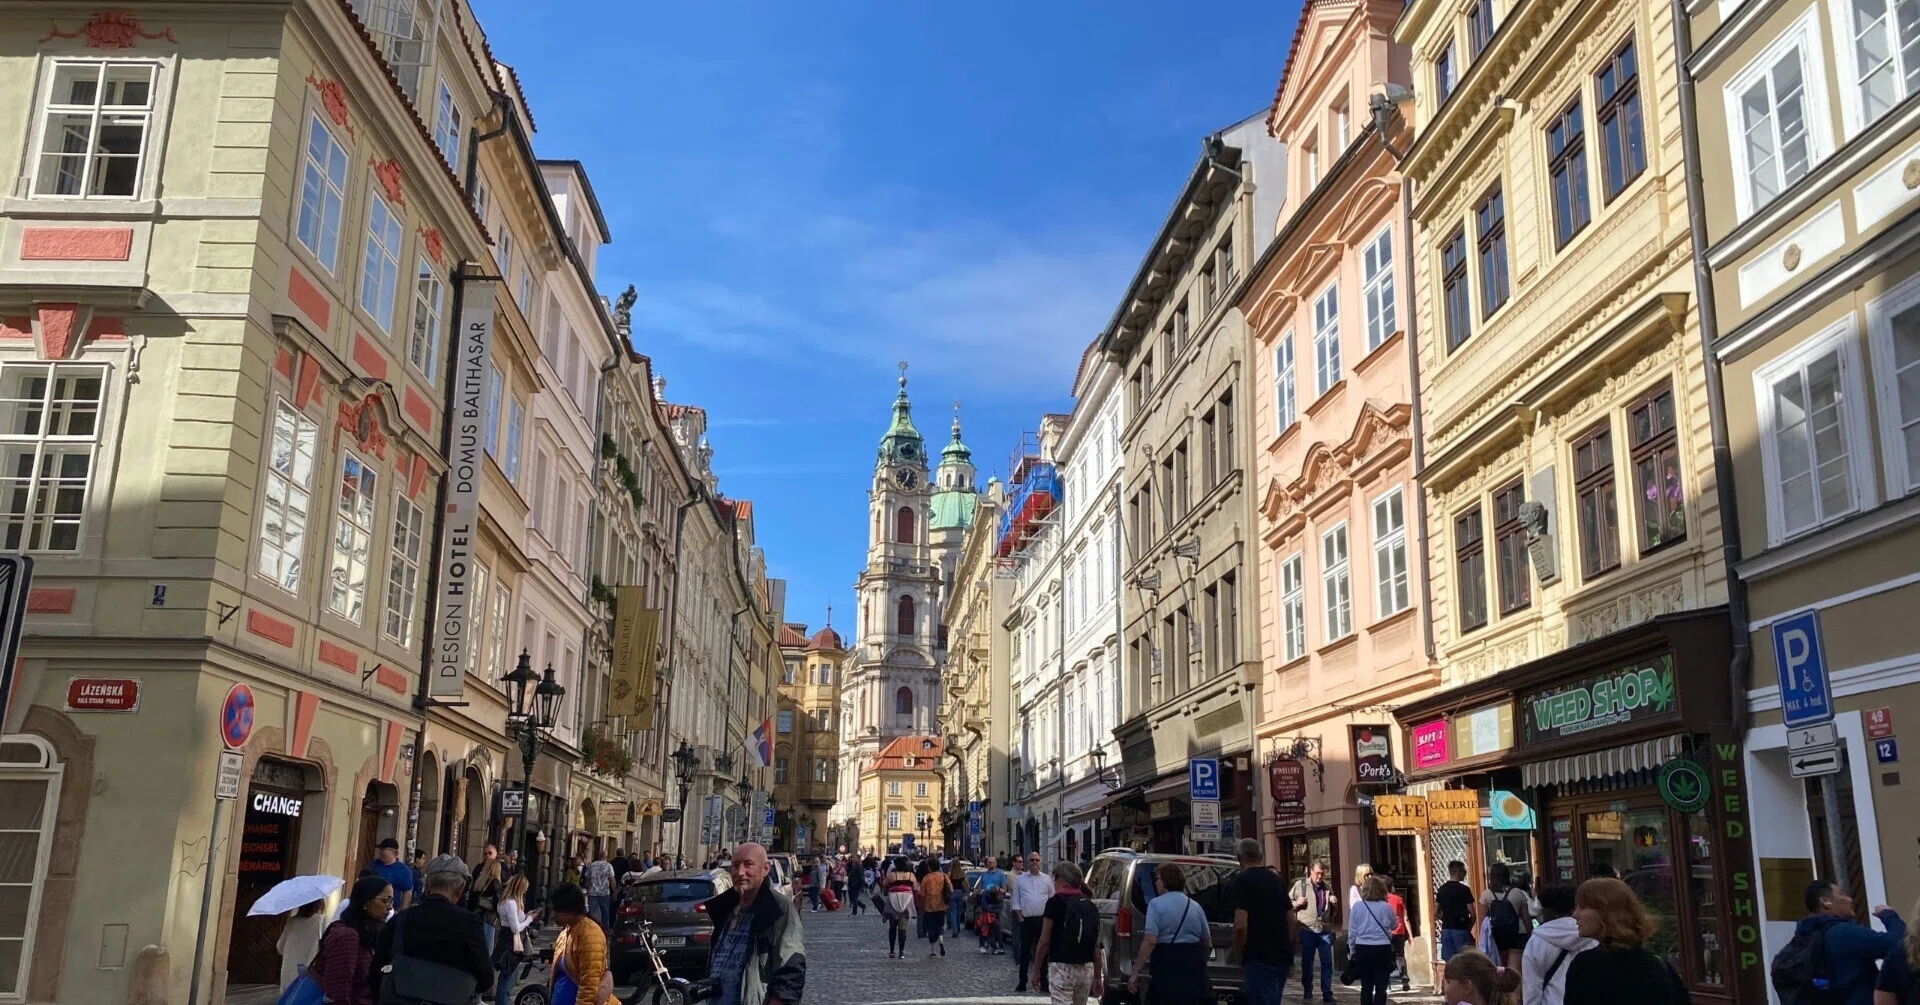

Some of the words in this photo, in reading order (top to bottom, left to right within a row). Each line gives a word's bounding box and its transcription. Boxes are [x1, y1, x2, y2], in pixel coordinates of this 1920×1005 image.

[463, 322, 485, 418] BALTHASAR
[457, 425, 477, 493] DOMUS
[448, 524, 469, 595] HOTEL
[441, 604, 462, 677] DESIGN
[1782, 629, 1810, 691] P
[80, 684, 124, 696] LÁZEŇSKÁ
[1533, 687, 1592, 731] WEED
[1592, 667, 1657, 717] SHOP
[1803, 698, 1808, 708] 4
[1871, 710, 1884, 723] 49
[1804, 731, 1816, 745] 2x
[1879, 744, 1892, 757] 12
[1196, 764, 1212, 787] P
[1273, 767, 1300, 775] JEWELLERY
[1359, 763, 1391, 777] Pork's
[254, 793, 302, 817] CHANGE
[1377, 801, 1425, 818] CAFÉ
[1430, 800, 1478, 810] GALERIE
[242, 843, 279, 853] ECHSEL
[1716, 744, 1744, 838] WEED
[1733, 872, 1758, 970] SHOP
